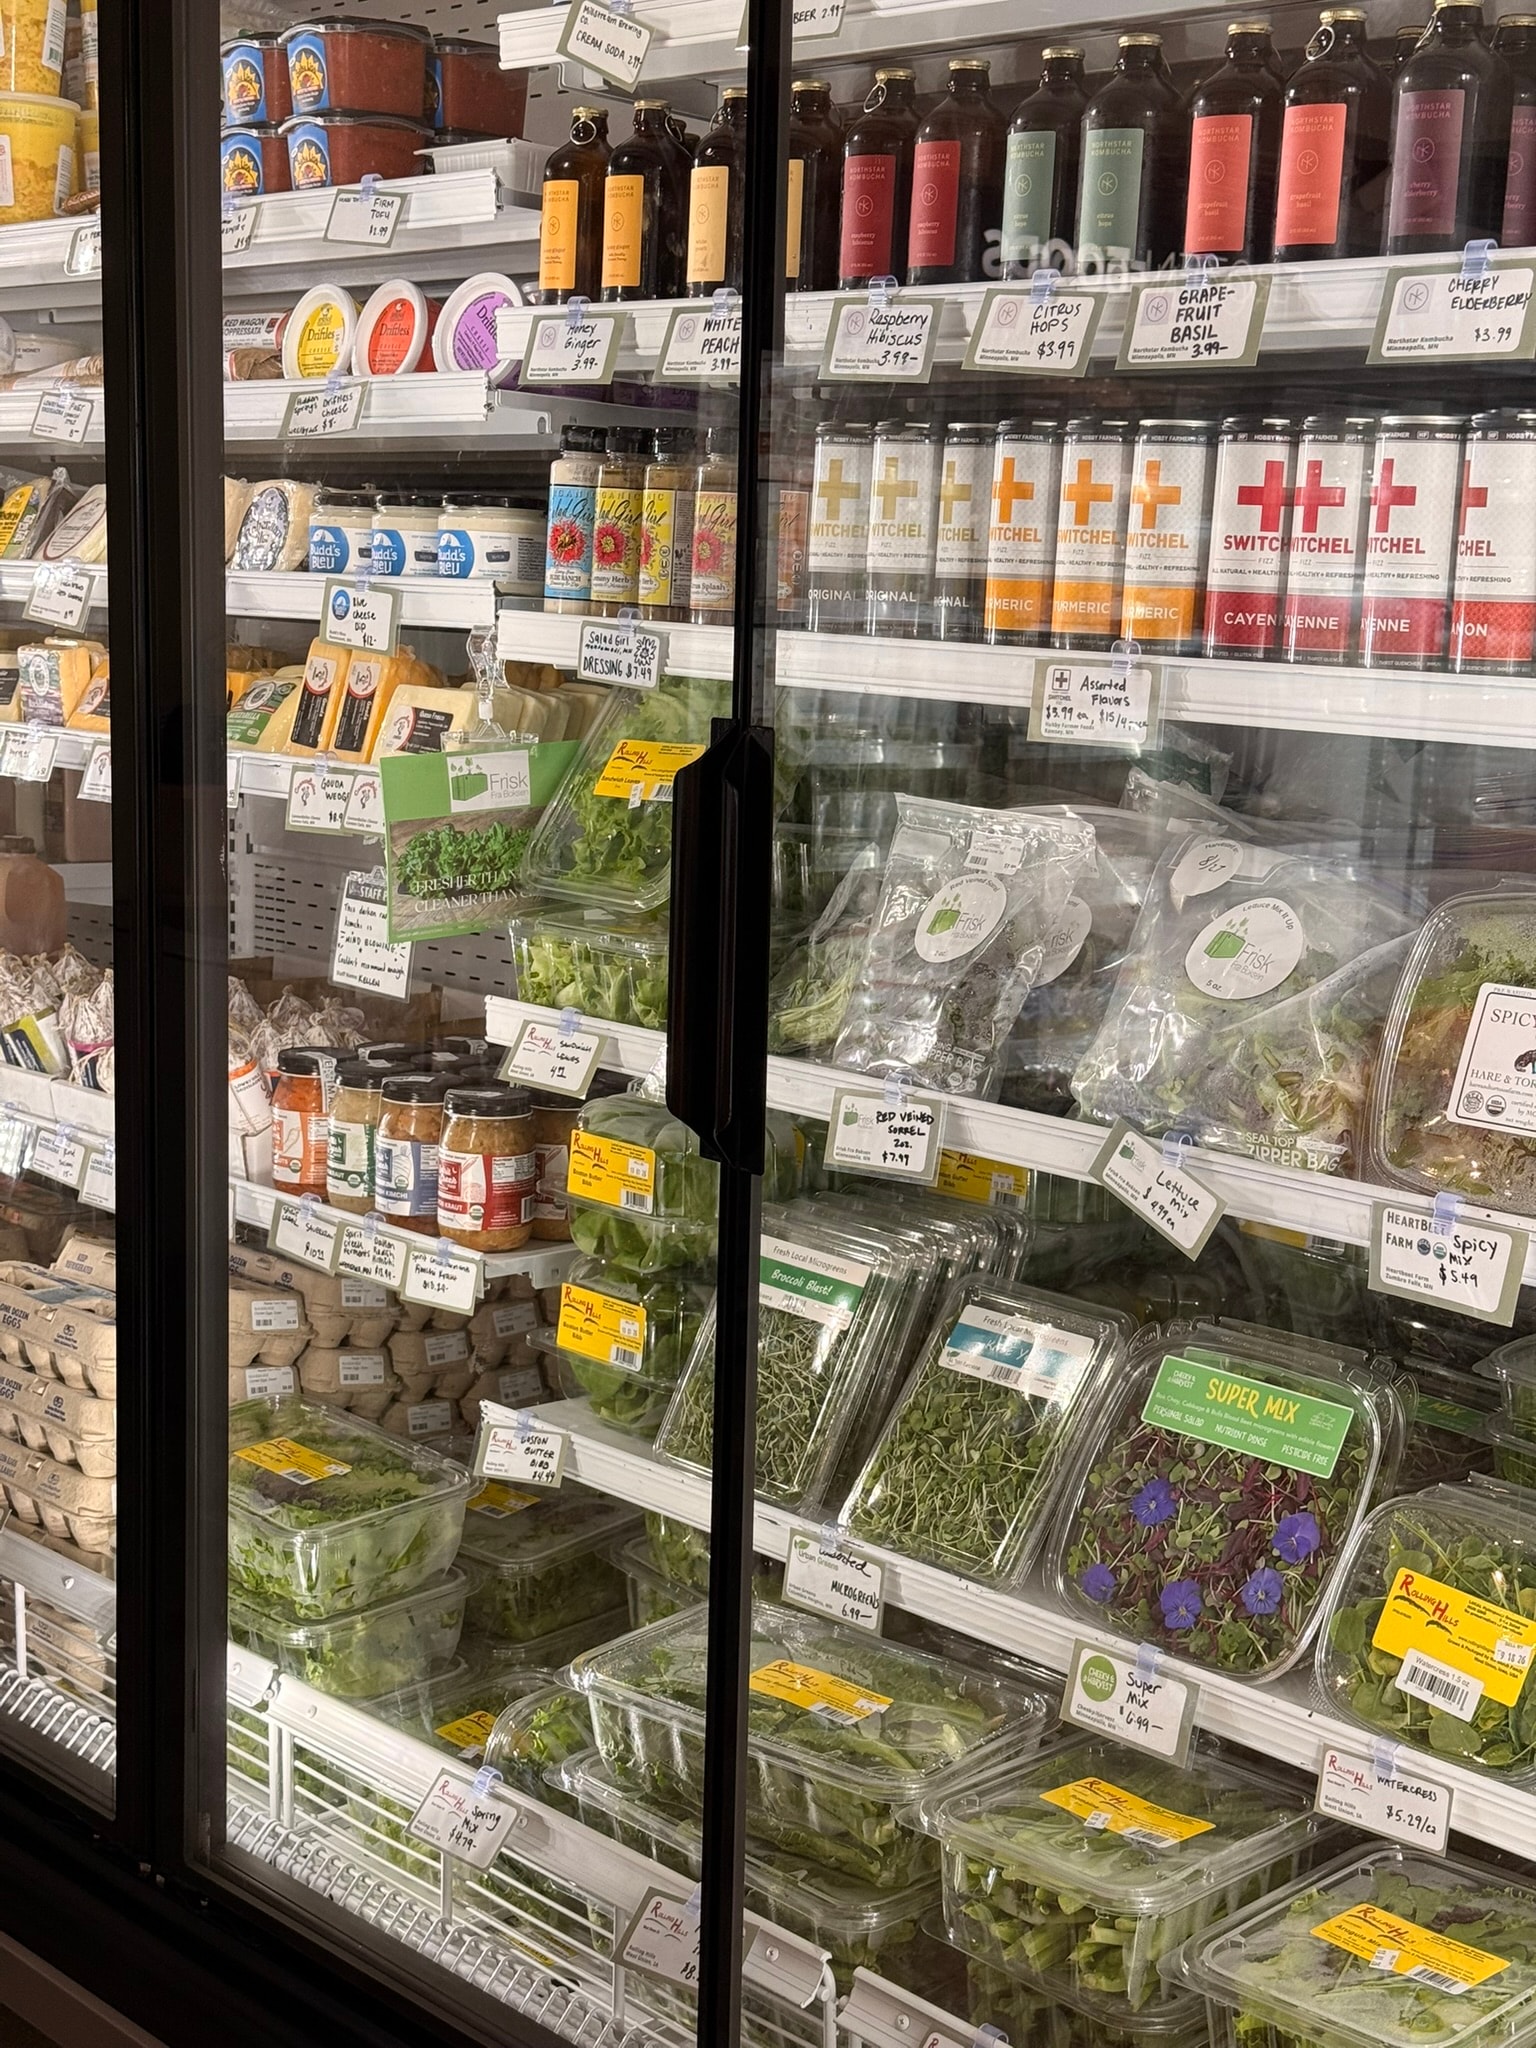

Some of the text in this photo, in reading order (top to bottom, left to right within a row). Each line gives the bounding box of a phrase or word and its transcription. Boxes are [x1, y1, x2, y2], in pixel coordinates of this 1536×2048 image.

[793, 8, 816, 25] BEER
[618, 19, 642, 38] Brewing
[576, 30, 626, 61] CREAM SODA
[373, 197, 394, 209] FIRM
[1448, 275, 1499, 294] CHERRY
[1178, 286, 1235, 306] GRAPE-
[1451, 292, 1533, 311] ELDERBERRY
[868, 307, 928, 330] Raspberry
[1033, 303, 1082, 320] CITRUS
[1175, 304, 1223, 323] FRUIT
[239, 316, 266, 328] WAGON
[379, 323, 410, 338] Driftless
[703, 317, 741, 333] WHITE
[1030, 317, 1069, 336] HOPS
[866, 331, 922, 348] Hibiscus
[1170, 324, 1218, 344] BASIL
[1474, 326, 1512, 344] $3.99
[564, 338, 601, 357] Ginger
[701, 336, 741, 355] PEACH
[1037, 341, 1075, 360] $3.99
[322, 392, 353, 408] Driftless
[589, 631, 612, 644] Salad
[583, 656, 652, 681] DRESSING $7.49
[1080, 675, 1127, 692] Assorted
[321, 777, 344, 790] GOUDA
[489, 772, 529, 791] Frisk
[415, 869, 517, 893] FRESHER THAN
[360, 886, 382, 901] STAFF
[415, 887, 518, 914] CLEANER THAN
[956, 912, 985, 932] Frisk
[1272, 903, 1283, 916] Mix
[1286, 918, 1294, 931] Up
[1239, 942, 1276, 974] Frisk
[1205, 979, 1212, 988] 5
[955, 1056, 984, 1074] BAG
[1470, 1068, 1513, 1085] HARE &
[876, 1110, 934, 1125] RED VEINED
[888, 1126, 925, 1136] SORREL
[1246, 1132, 1294, 1147] SEAL TOP
[1248, 1143, 1340, 1172] ZIPPER BAG
[1155, 1170, 1200, 1212] Lettuce
[1386, 1232, 1413, 1250] FARM
[1453, 1235, 1498, 1260] Spicy
[772, 1246, 848, 1276] Fresh Local Microgreens
[1449, 1252, 1473, 1266] Mix
[771, 1268, 834, 1297] Broccoli Blast!
[2, 1314, 22, 1329] EGGS
[1205, 1377, 1301, 1425] SUPER MIX
[1152, 1405, 1184, 1422] PERSONAL
[1214, 1424, 1248, 1442] NUTRIENT
[1281, 1444, 1313, 1462] PESTICIDE
[1312, 1452, 1330, 1467] FREE
[1286, 1431, 1298, 1441] with
[1298, 1434, 1316, 1446] edible
[1316, 1439, 1336, 1451] flowers
[524, 1447, 555, 1459] BUTTER
[799, 1549, 816, 1562] Urban
[830, 1579, 880, 1610] MICROGREENS
[1399, 1574, 1436, 1606] ROLLING
[1432, 1599, 1460, 1628] HILLS
[1415, 1656, 1470, 1688] Watercress 1.5 oz
[1126, 1672, 1162, 1697] Super
[1126, 1691, 1149, 1709] Mix
[1377, 1775, 1437, 1802] WATERCRESS
[461, 1817, 479, 1833] Mix
[471, 1805, 501, 1831] Spring
[1335, 1924, 1367, 1942] Arugula
